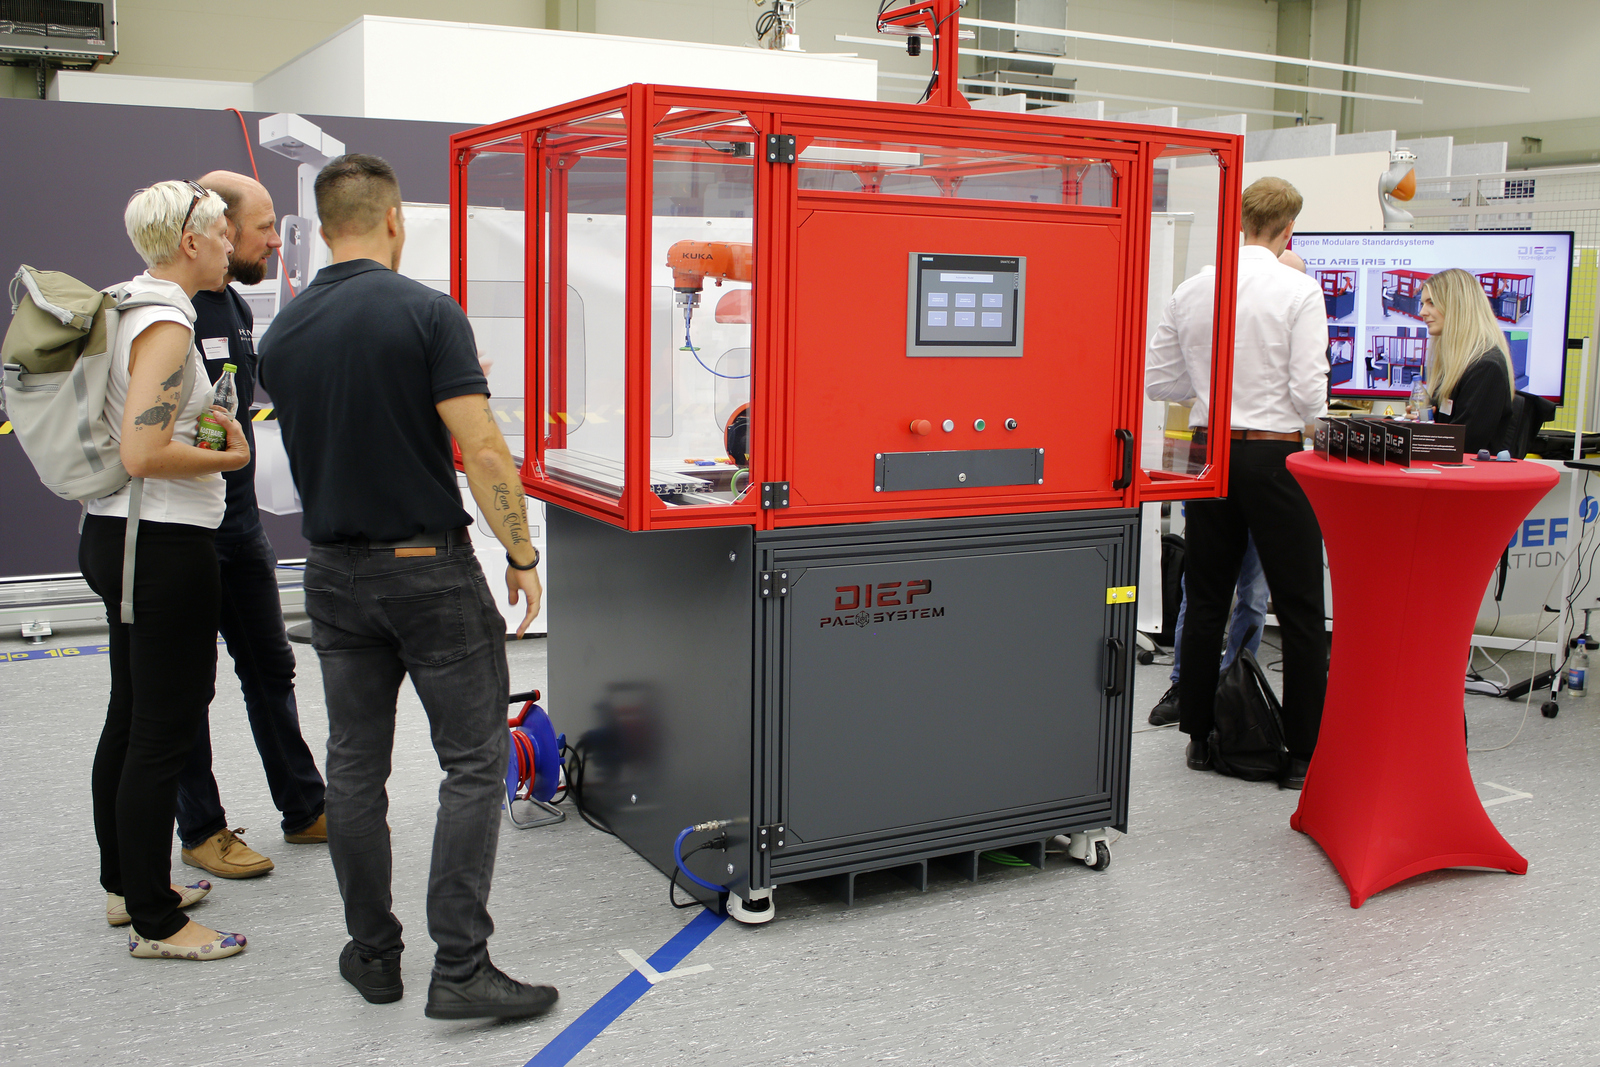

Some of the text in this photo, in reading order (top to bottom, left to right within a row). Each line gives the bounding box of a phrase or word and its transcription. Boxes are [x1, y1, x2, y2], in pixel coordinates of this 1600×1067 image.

[1292, 238, 1435, 247] Eigene Modulare Standardsysteme
[682, 252, 714, 260] KUKA
[1517, 246, 1557, 255] DIEP
[1302, 258, 1326, 266] ACO
[1329, 258, 1359, 266] ARIS
[1361, 258, 1386, 266] IRIS
[1350, 430, 1365, 444] DIEP
[1386, 433, 1404, 447] DIEP
[834, 579, 932, 611] DIEP
[873, 606, 945, 623] SYSTEM
